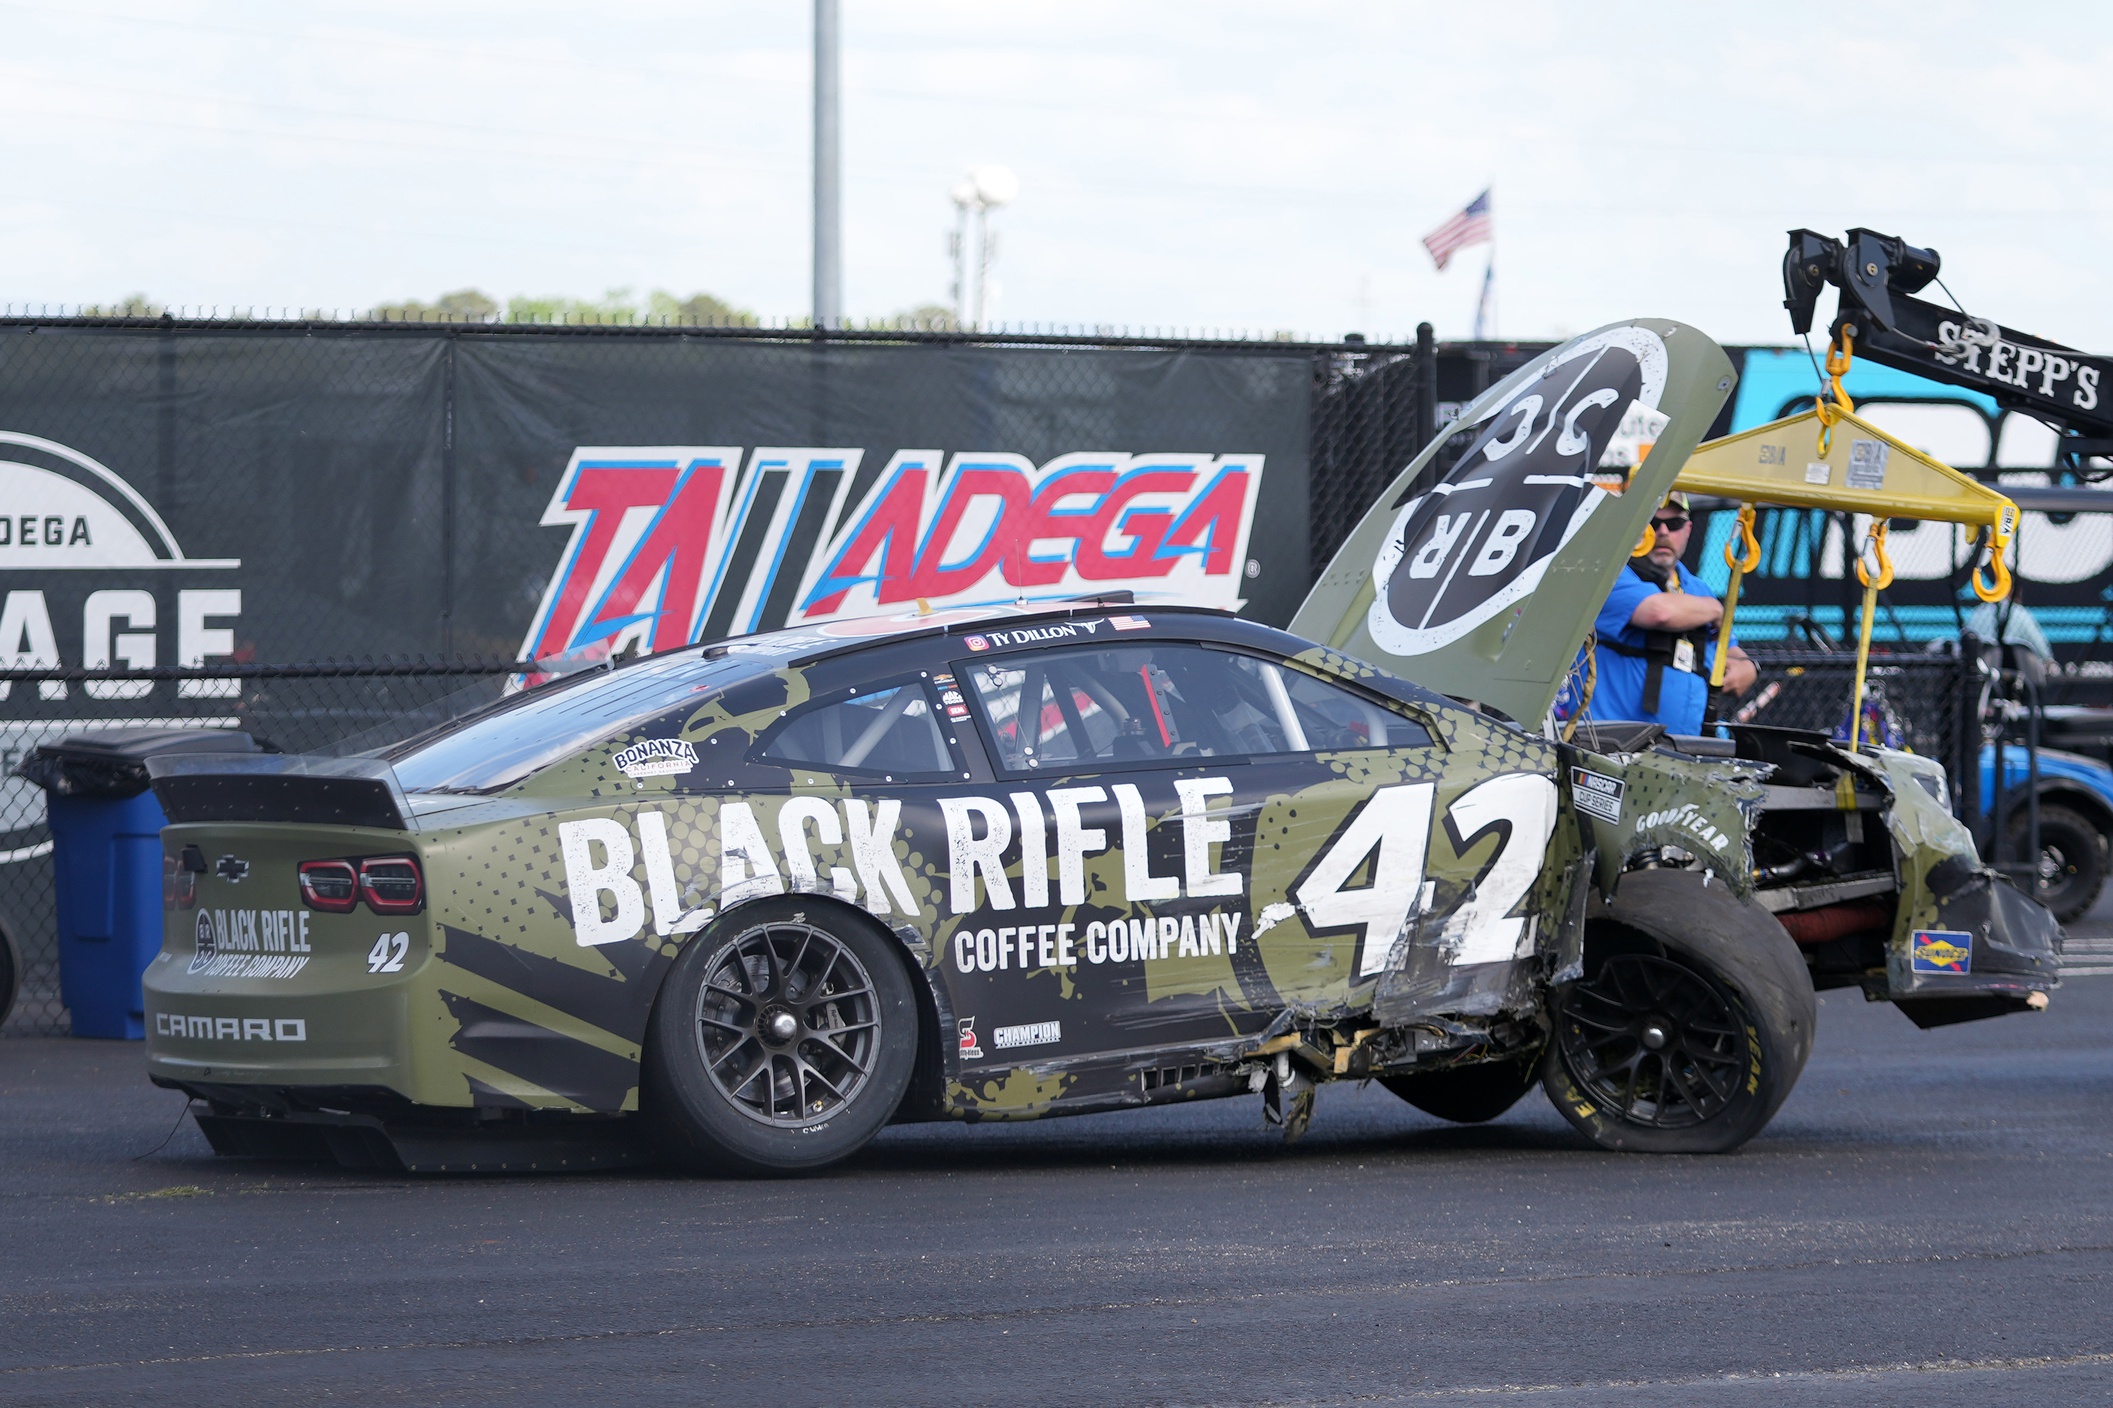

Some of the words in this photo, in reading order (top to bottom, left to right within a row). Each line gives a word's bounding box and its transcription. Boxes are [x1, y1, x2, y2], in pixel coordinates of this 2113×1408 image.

[1935, 320, 2100, 410] STEPP'S
[986, 632, 1009, 647] TY
[1011, 625, 1077, 645] DILLON
[614, 740, 699, 769] BONANZA
[625, 760, 691, 773] CALIFORNIA
[1586, 774, 1618, 796] NASCAR
[1579, 790, 1592, 804] CUP
[1591, 793, 1615, 813] SERIES
[1636, 803, 1730, 852] GOODYEAR
[558, 796, 921, 947] BLACK
[936, 776, 1244, 914] RIFLE
[1294, 773, 1560, 977] 42
[214, 908, 260, 951] BLACK
[261, 909, 311, 952] RIFLE
[954, 923, 1077, 974] COFFEE
[1086, 912, 1242, 965] COMPANY
[204, 953, 252, 977] COFFEE
[240, 954, 311, 979] COMPANY
[367, 931, 410, 973] 42
[155, 1012, 307, 1041] CAMARO
[996, 1022, 1060, 1044] CHAMPION
